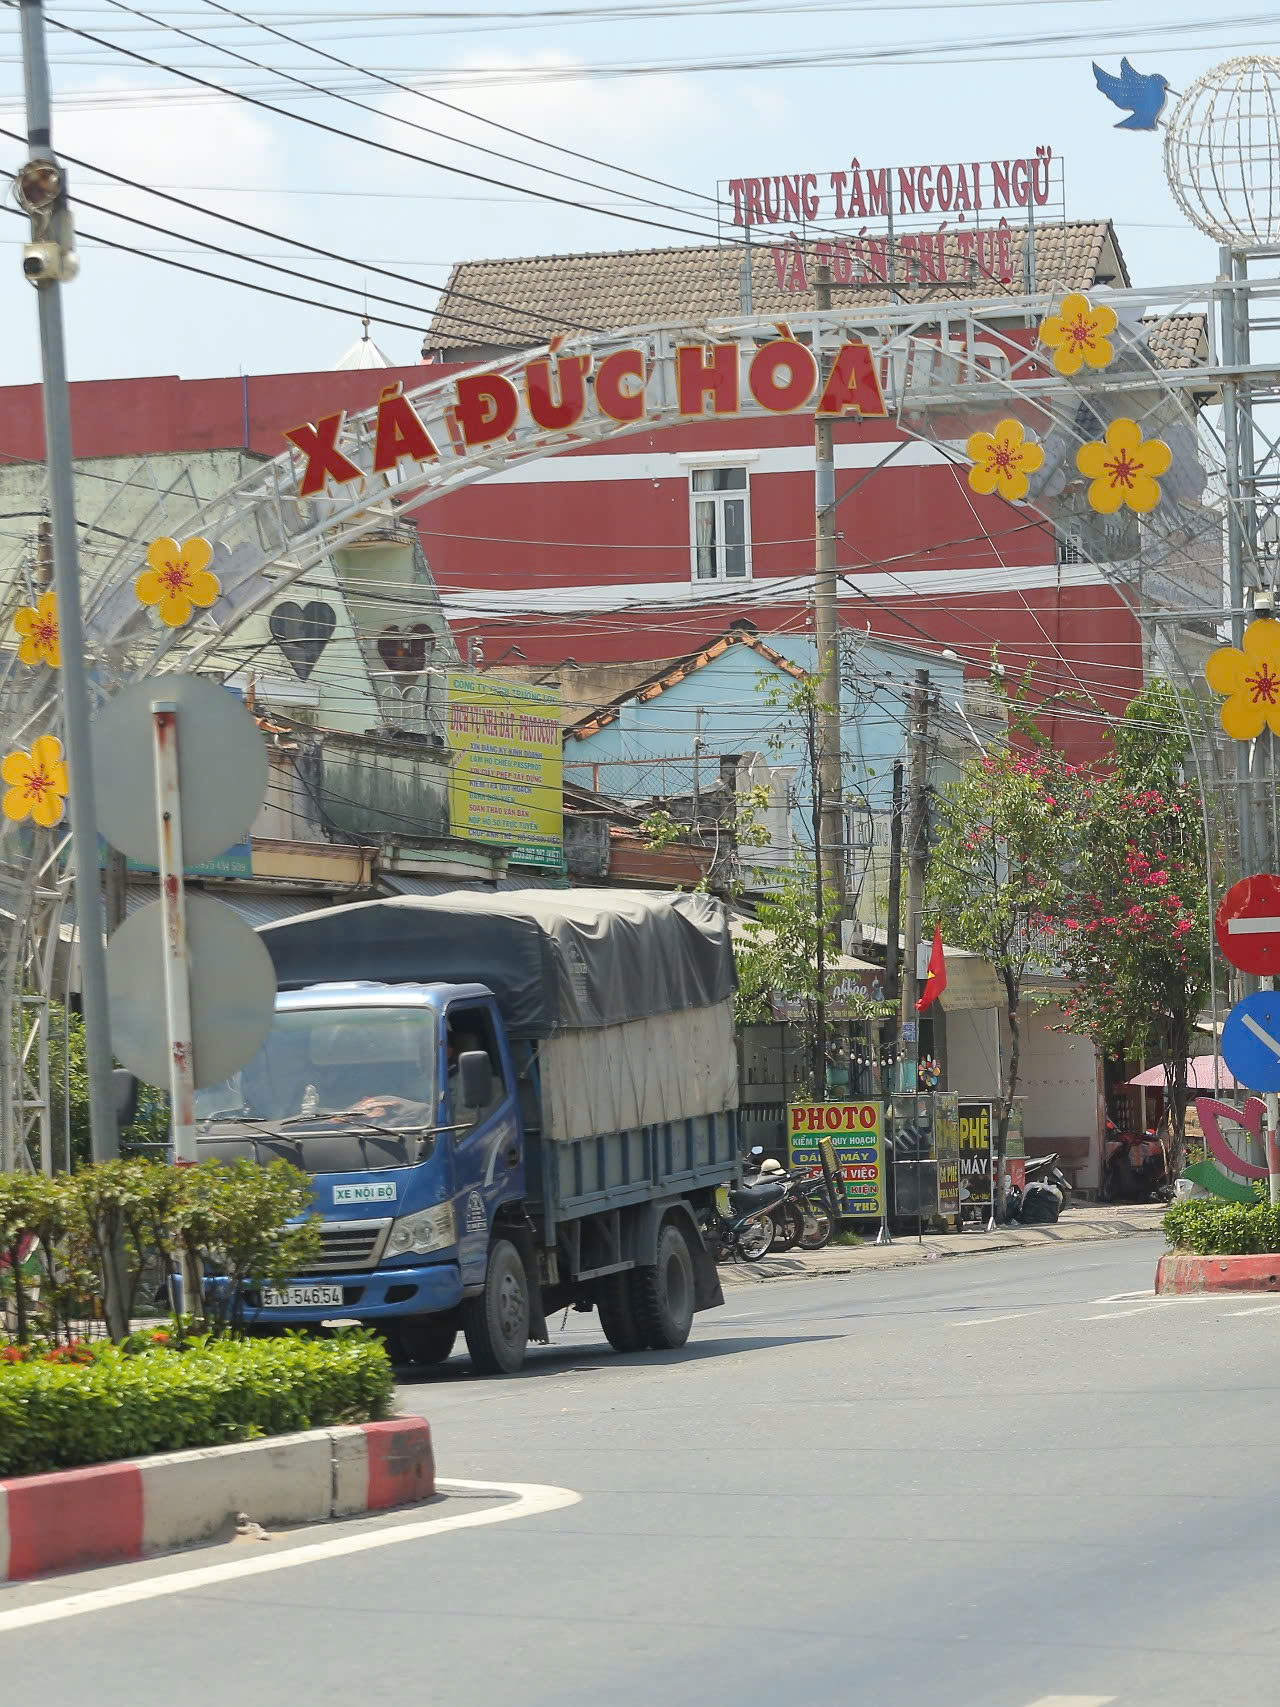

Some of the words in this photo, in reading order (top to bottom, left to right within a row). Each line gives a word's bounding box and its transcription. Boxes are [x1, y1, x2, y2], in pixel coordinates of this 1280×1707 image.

[728, 173, 820, 227] TRUNG
[831, 157, 889, 218] TÂM
[899, 162, 983, 223] NGOẠI
[993, 145, 1053, 208] NGỮ
[771, 231, 807, 292] VÀ
[815, 226, 888, 284] TOÁN
[901, 220, 948, 283] TRÍ
[957, 216, 1014, 284] TUỆ
[282, 381, 442, 498] XÃ
[452, 335, 646, 447] ĐỨC
[677, 322, 889, 418] HÒA
[791, 1105, 877, 1131] PHOTO
[960, 1108, 989, 1149] PHÊ
[792, 1135, 813, 1146] KIỂM
[833, 1137, 847, 1145] QUY
[849, 1136, 876, 1146] HOẠCH
[840, 1152, 870, 1161] MÁY
[960, 1154, 988, 1175] MÁY
[850, 1167, 876, 1180] VIỆC
[337, 1190, 351, 1199] XE
[355, 1186, 375, 1200] NỘI
[378, 1185, 393, 1199] BỘ
[851, 1184, 878, 1195] KIỆN
[854, 1199, 877, 1211] THẺ
